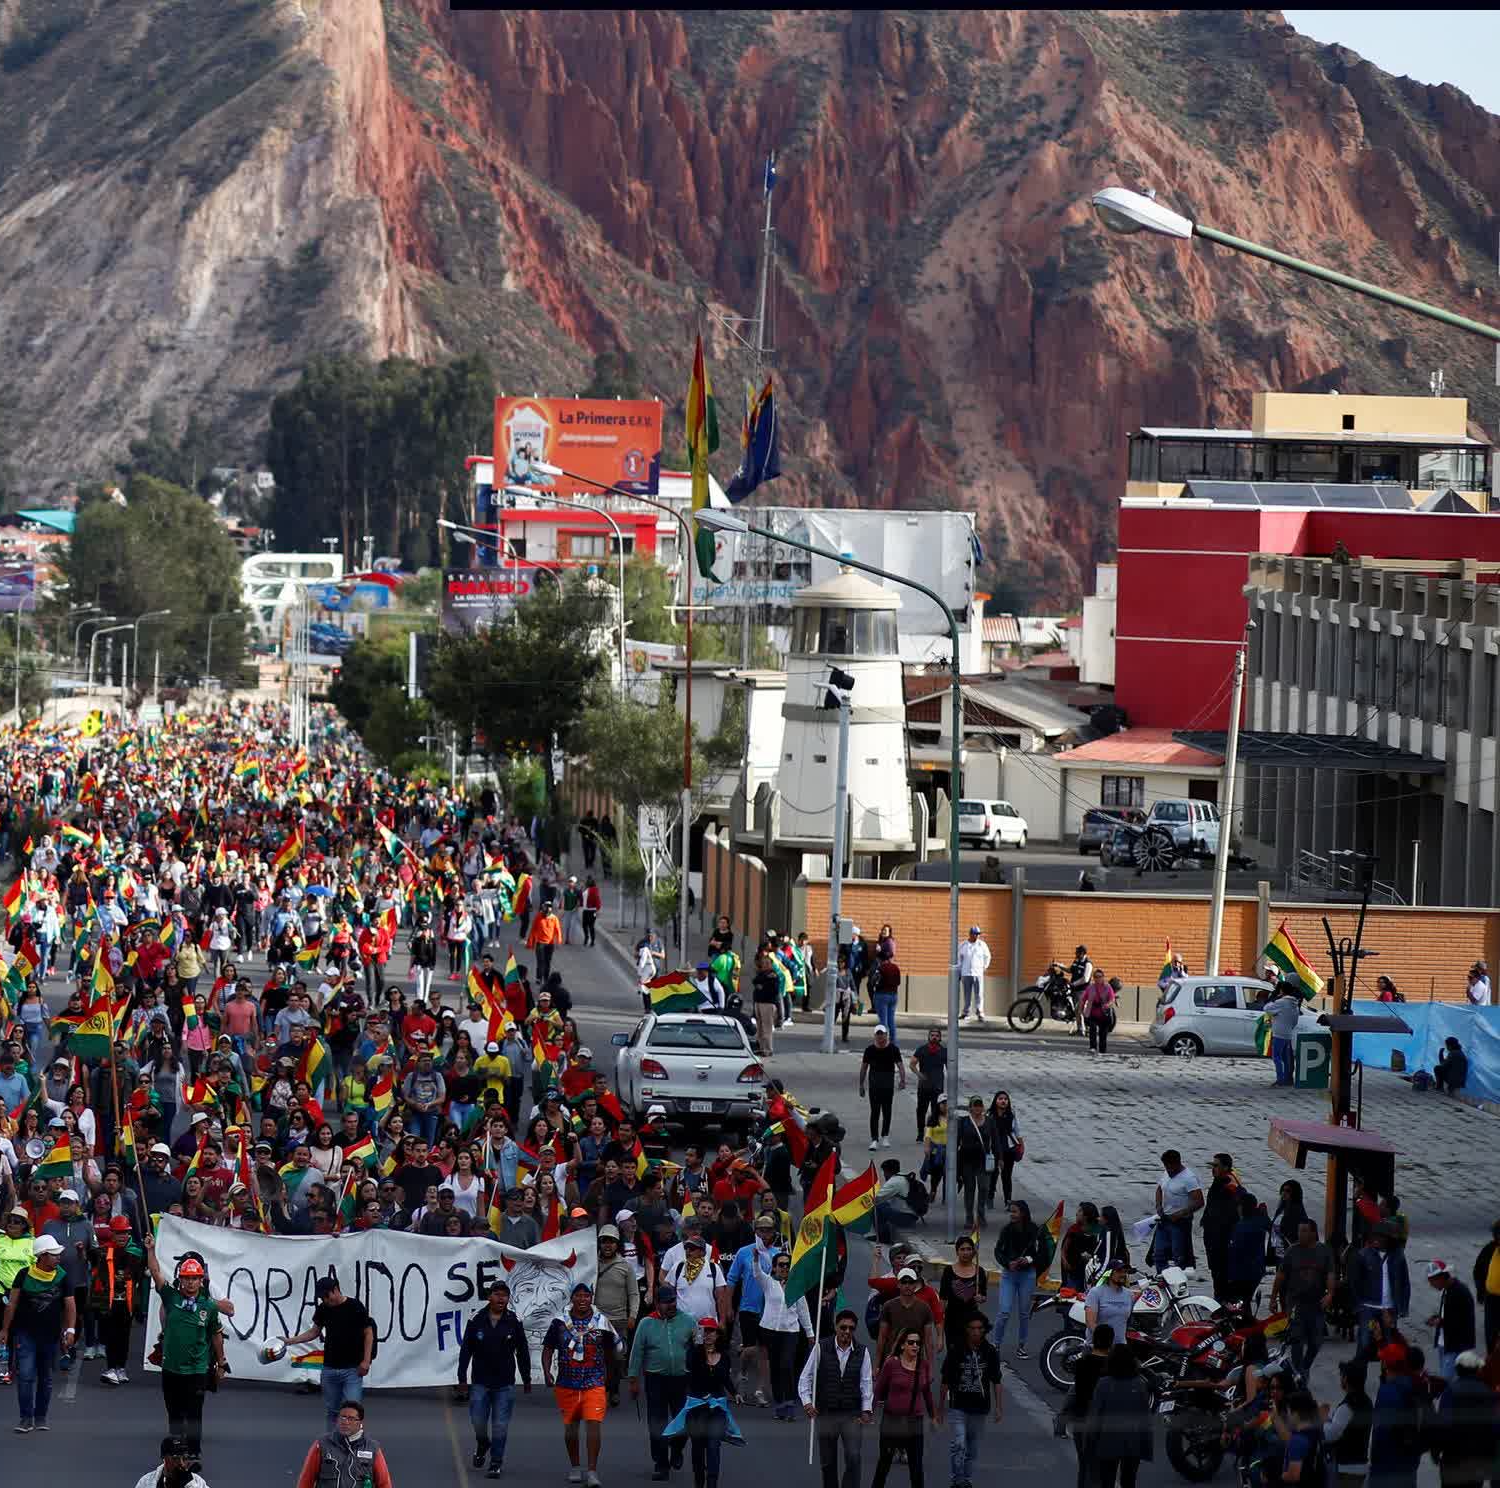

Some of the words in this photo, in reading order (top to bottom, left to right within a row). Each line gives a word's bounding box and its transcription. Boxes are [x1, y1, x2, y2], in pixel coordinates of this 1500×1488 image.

[559, 411, 574, 424] La
[576, 411, 627, 425] Primera
[448, 581, 531, 595] RAMBO
[1300, 1041, 1326, 1081] P
[227, 1260, 429, 1342] ORANDO
[443, 1260, 500, 1303] SE
